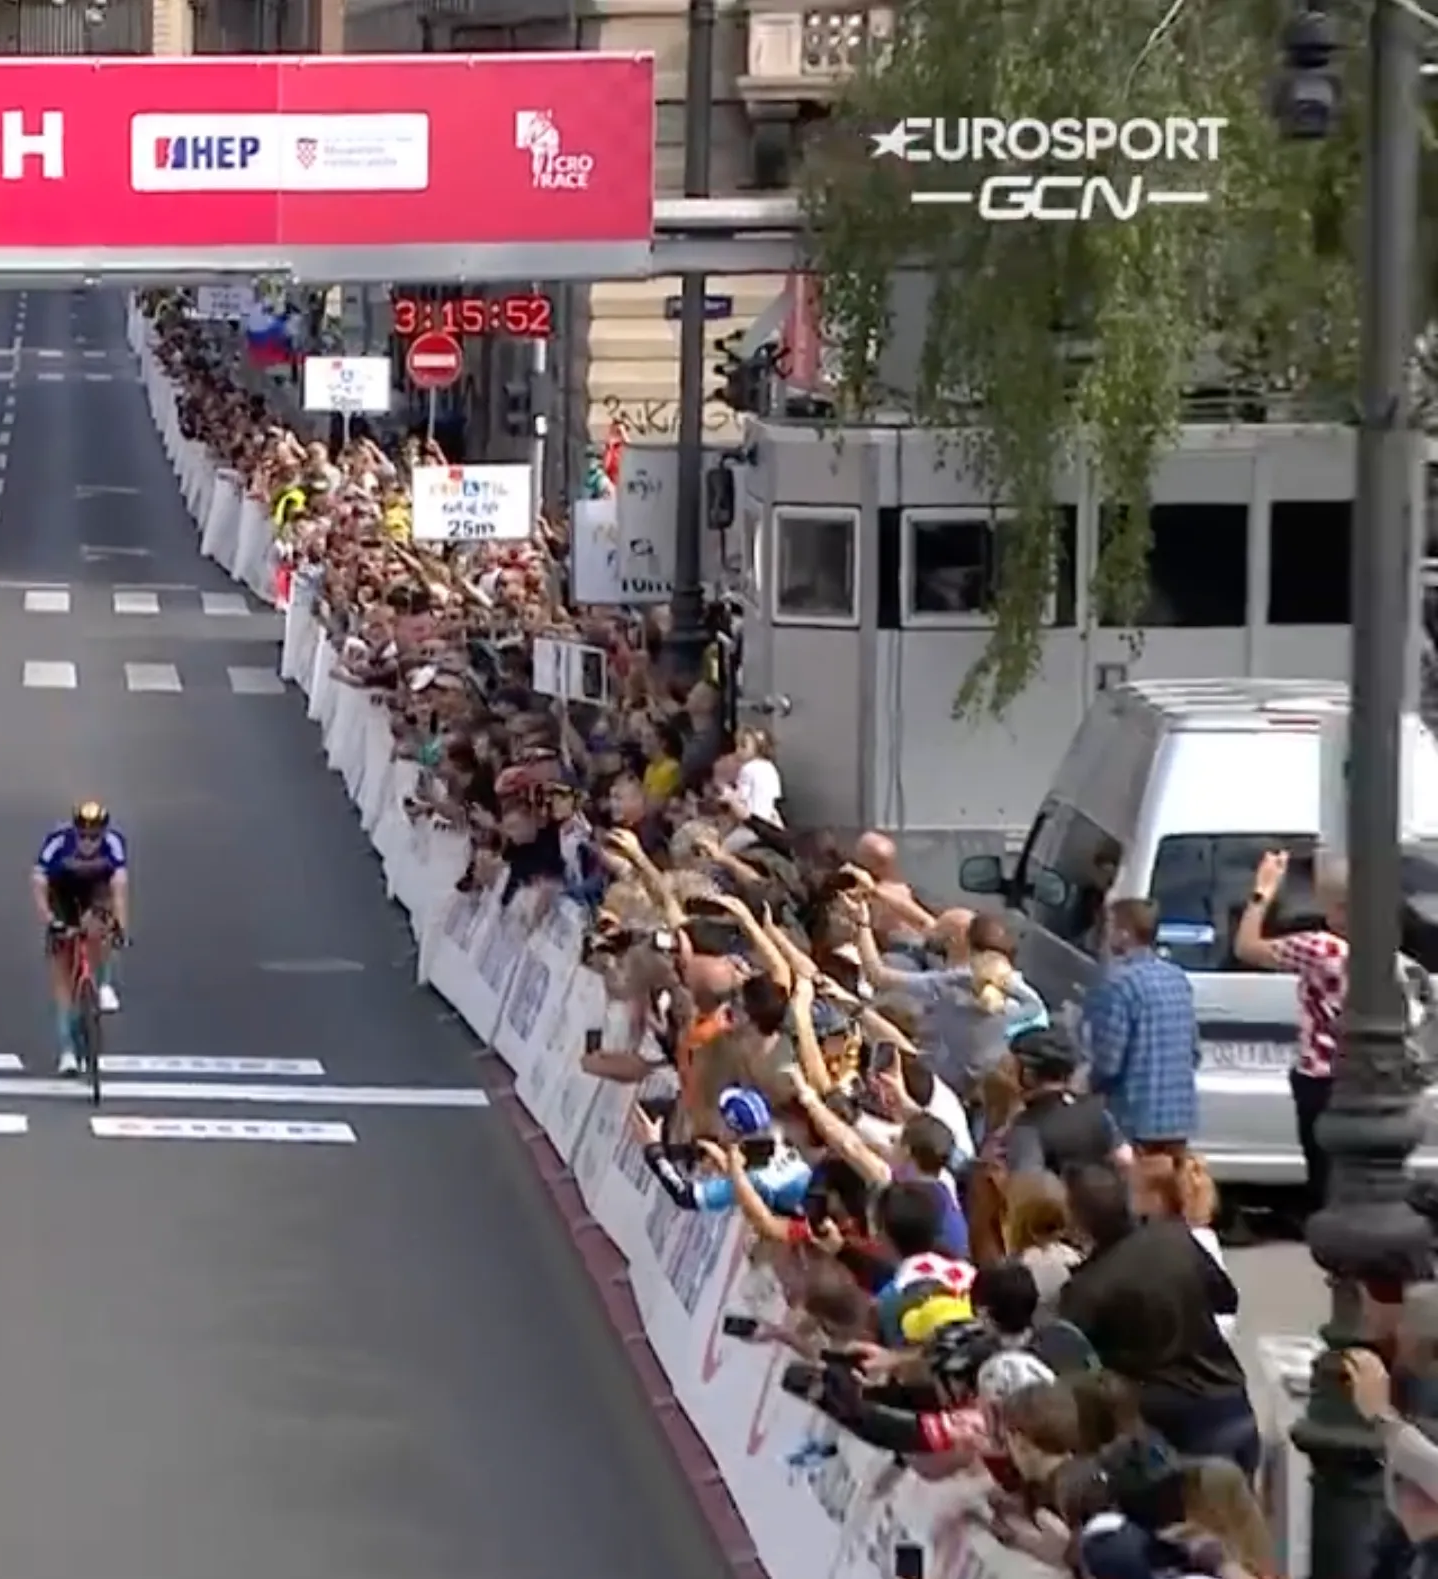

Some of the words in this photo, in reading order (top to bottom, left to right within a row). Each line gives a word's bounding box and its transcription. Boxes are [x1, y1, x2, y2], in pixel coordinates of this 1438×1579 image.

[191, 136, 260, 170] HEP
[555, 155, 593, 172] CRO
[541, 173, 589, 188] RACE
[394, 301, 551, 332] 3:15:52
[447, 520, 496, 538] 25m
